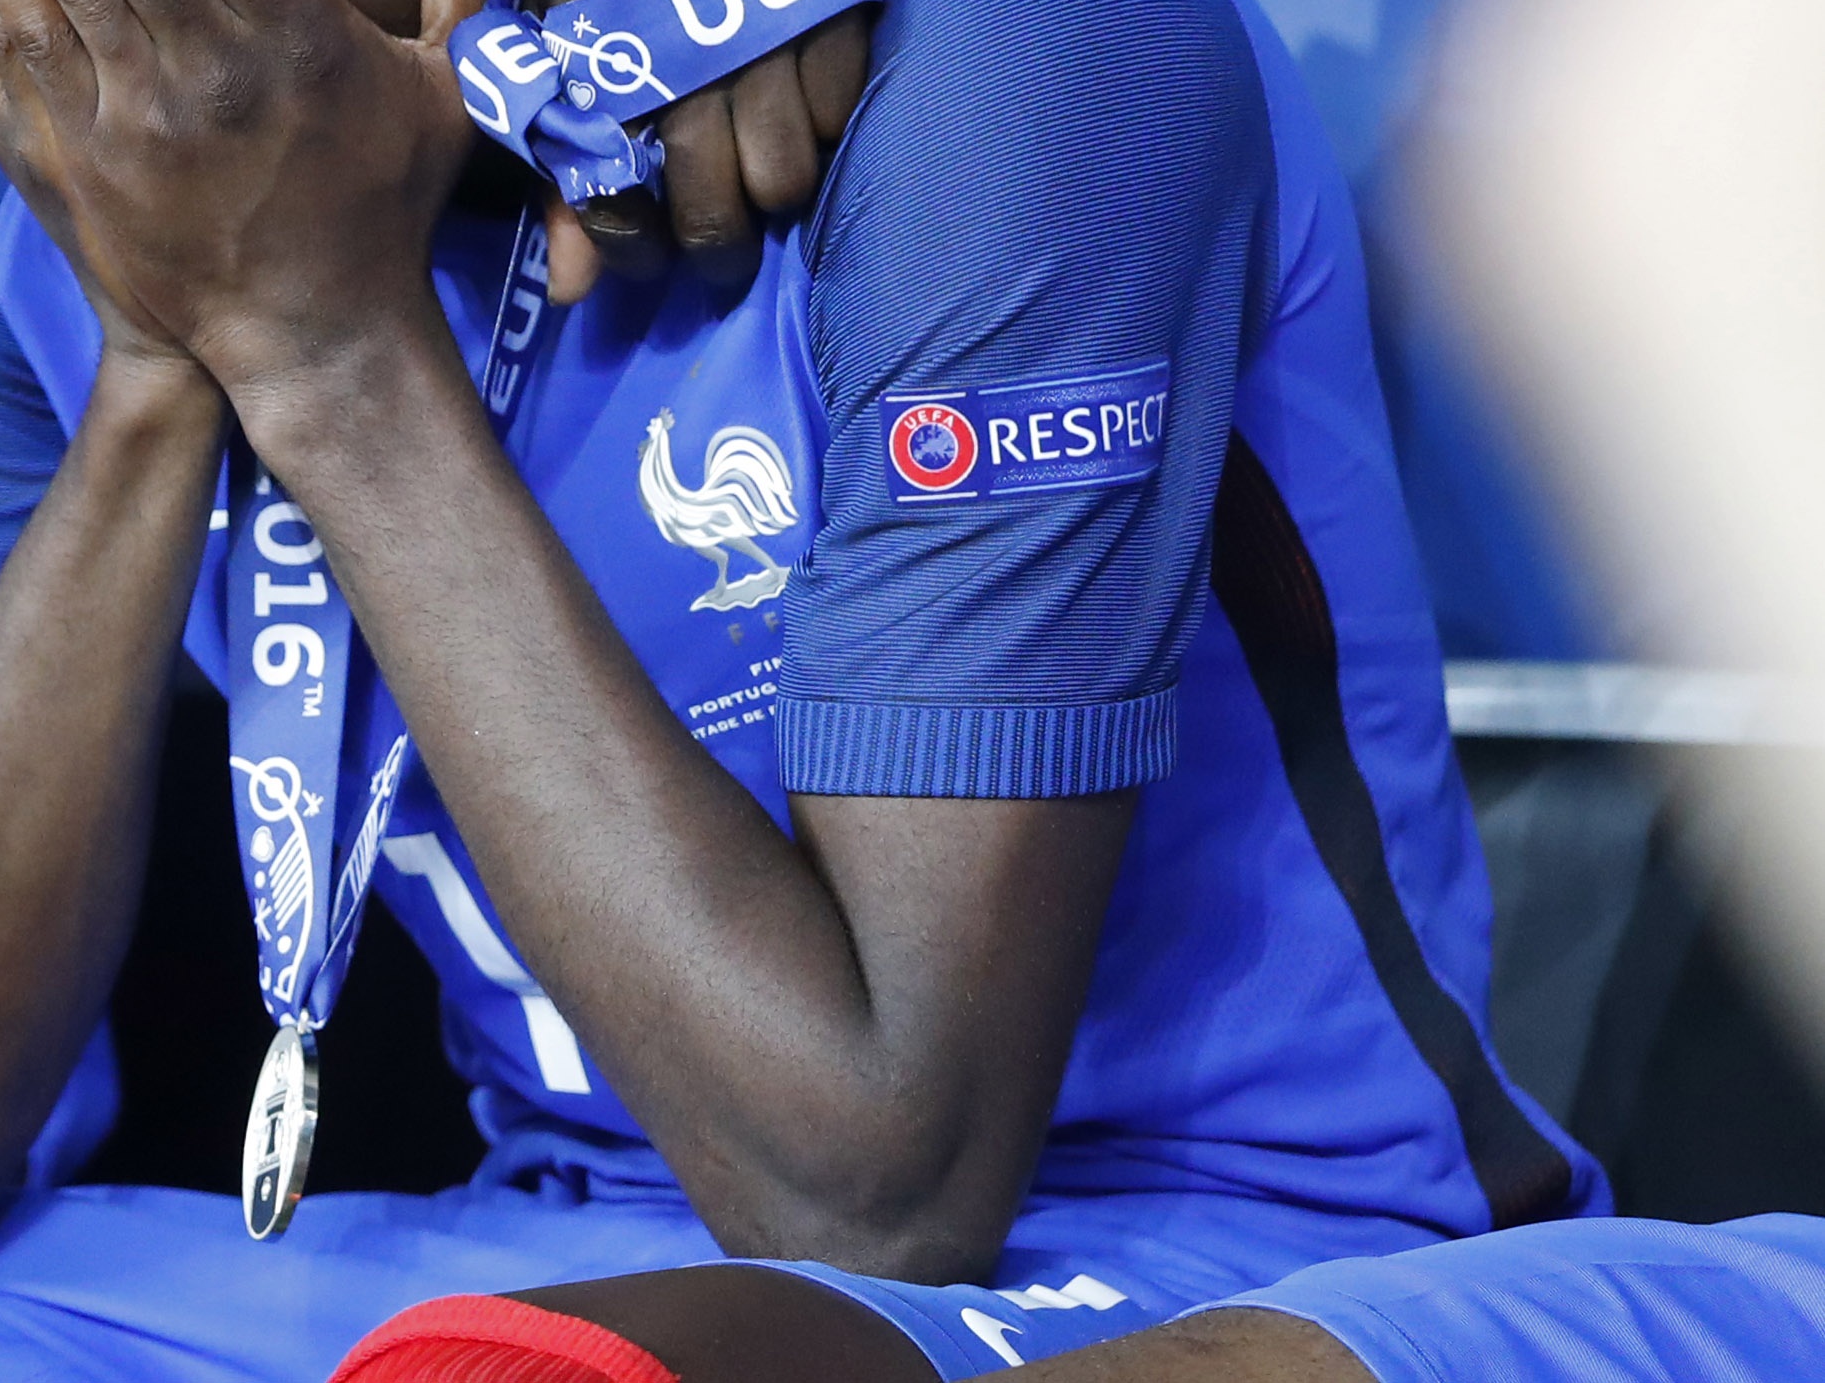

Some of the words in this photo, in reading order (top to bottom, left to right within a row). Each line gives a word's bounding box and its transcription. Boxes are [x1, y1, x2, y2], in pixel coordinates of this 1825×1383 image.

[458, 24, 558, 134] UE
[489, 223, 550, 415] EUR
[904, 409, 954, 430] UEFA
[988, 392, 1167, 465] RESPECT
[688, 681, 778, 719] PORTUG
[742, 709, 765, 724] DE
